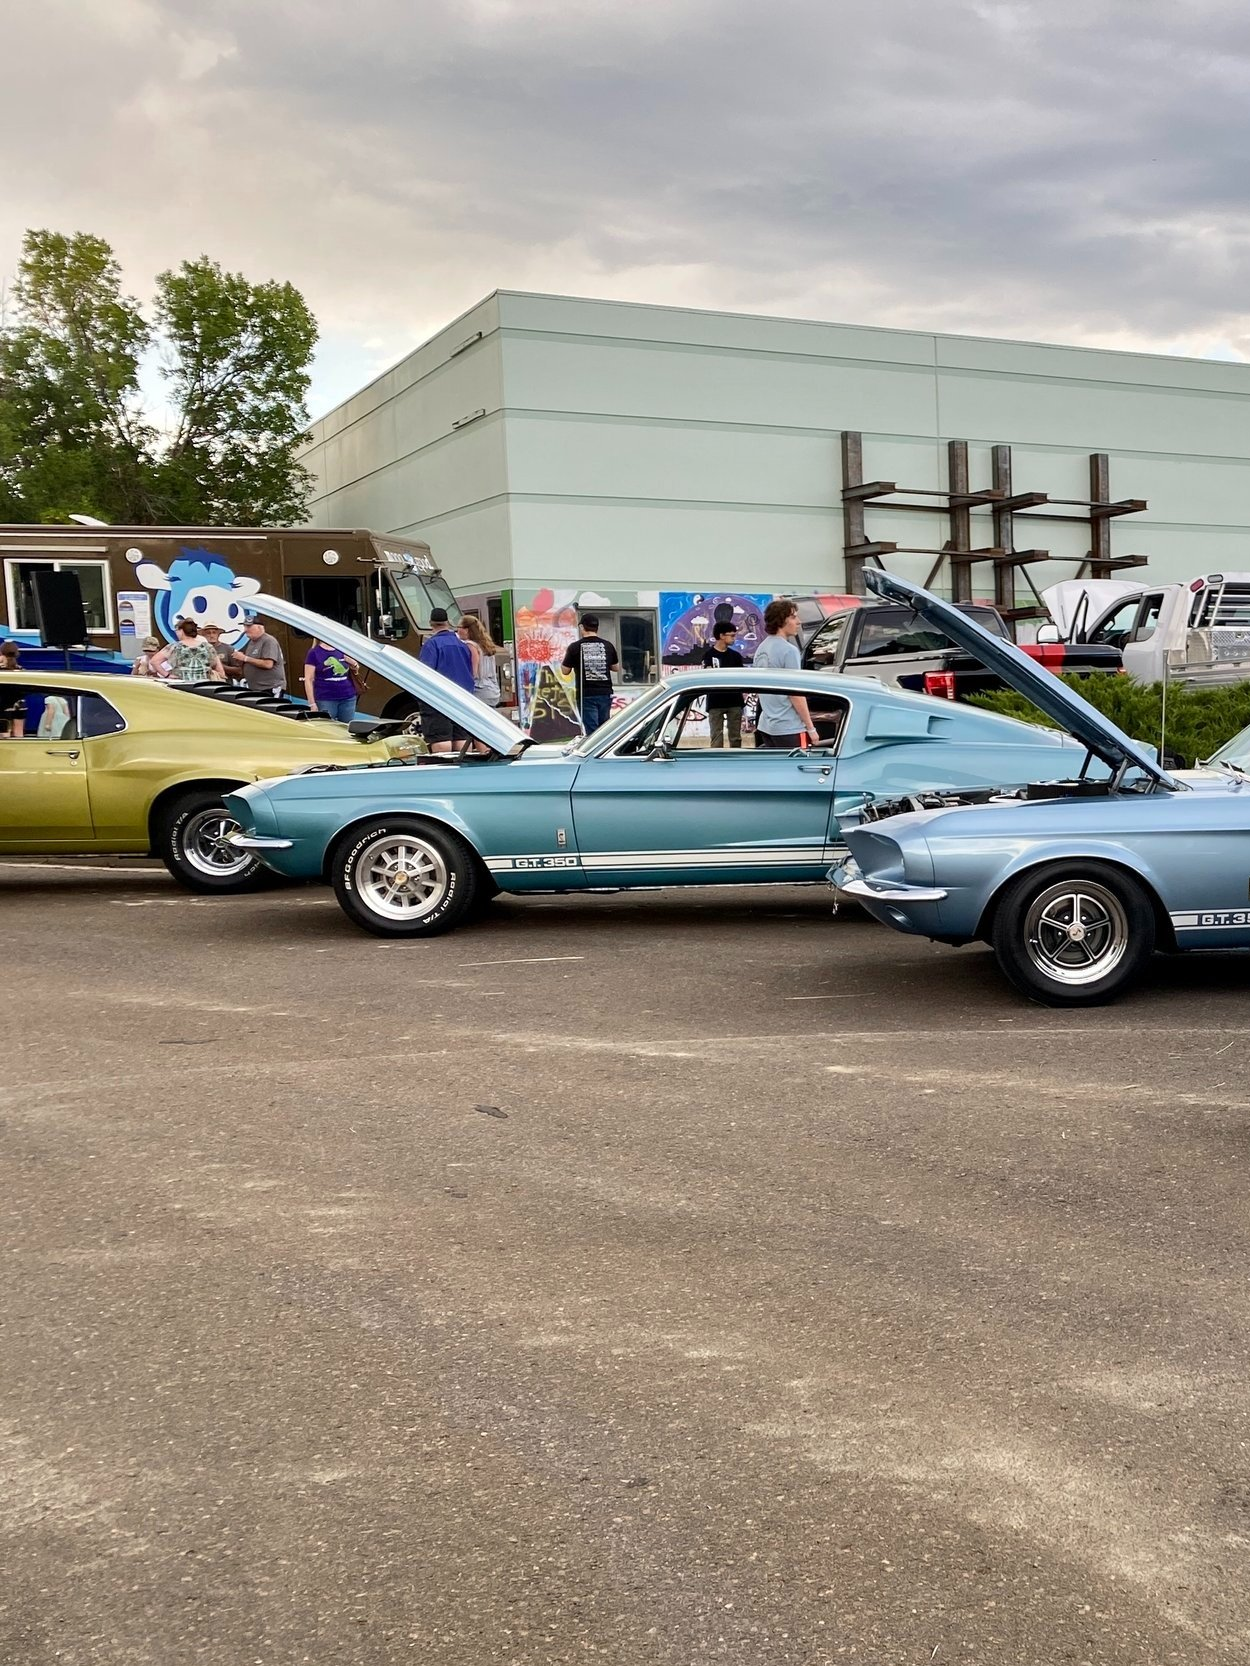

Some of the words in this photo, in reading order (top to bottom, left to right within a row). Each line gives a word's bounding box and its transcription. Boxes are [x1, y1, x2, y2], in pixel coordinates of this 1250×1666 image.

[344, 828, 387, 890] BFGoodrich
[440, 872, 456, 912] Radial
[422, 911, 441, 924] T/A
